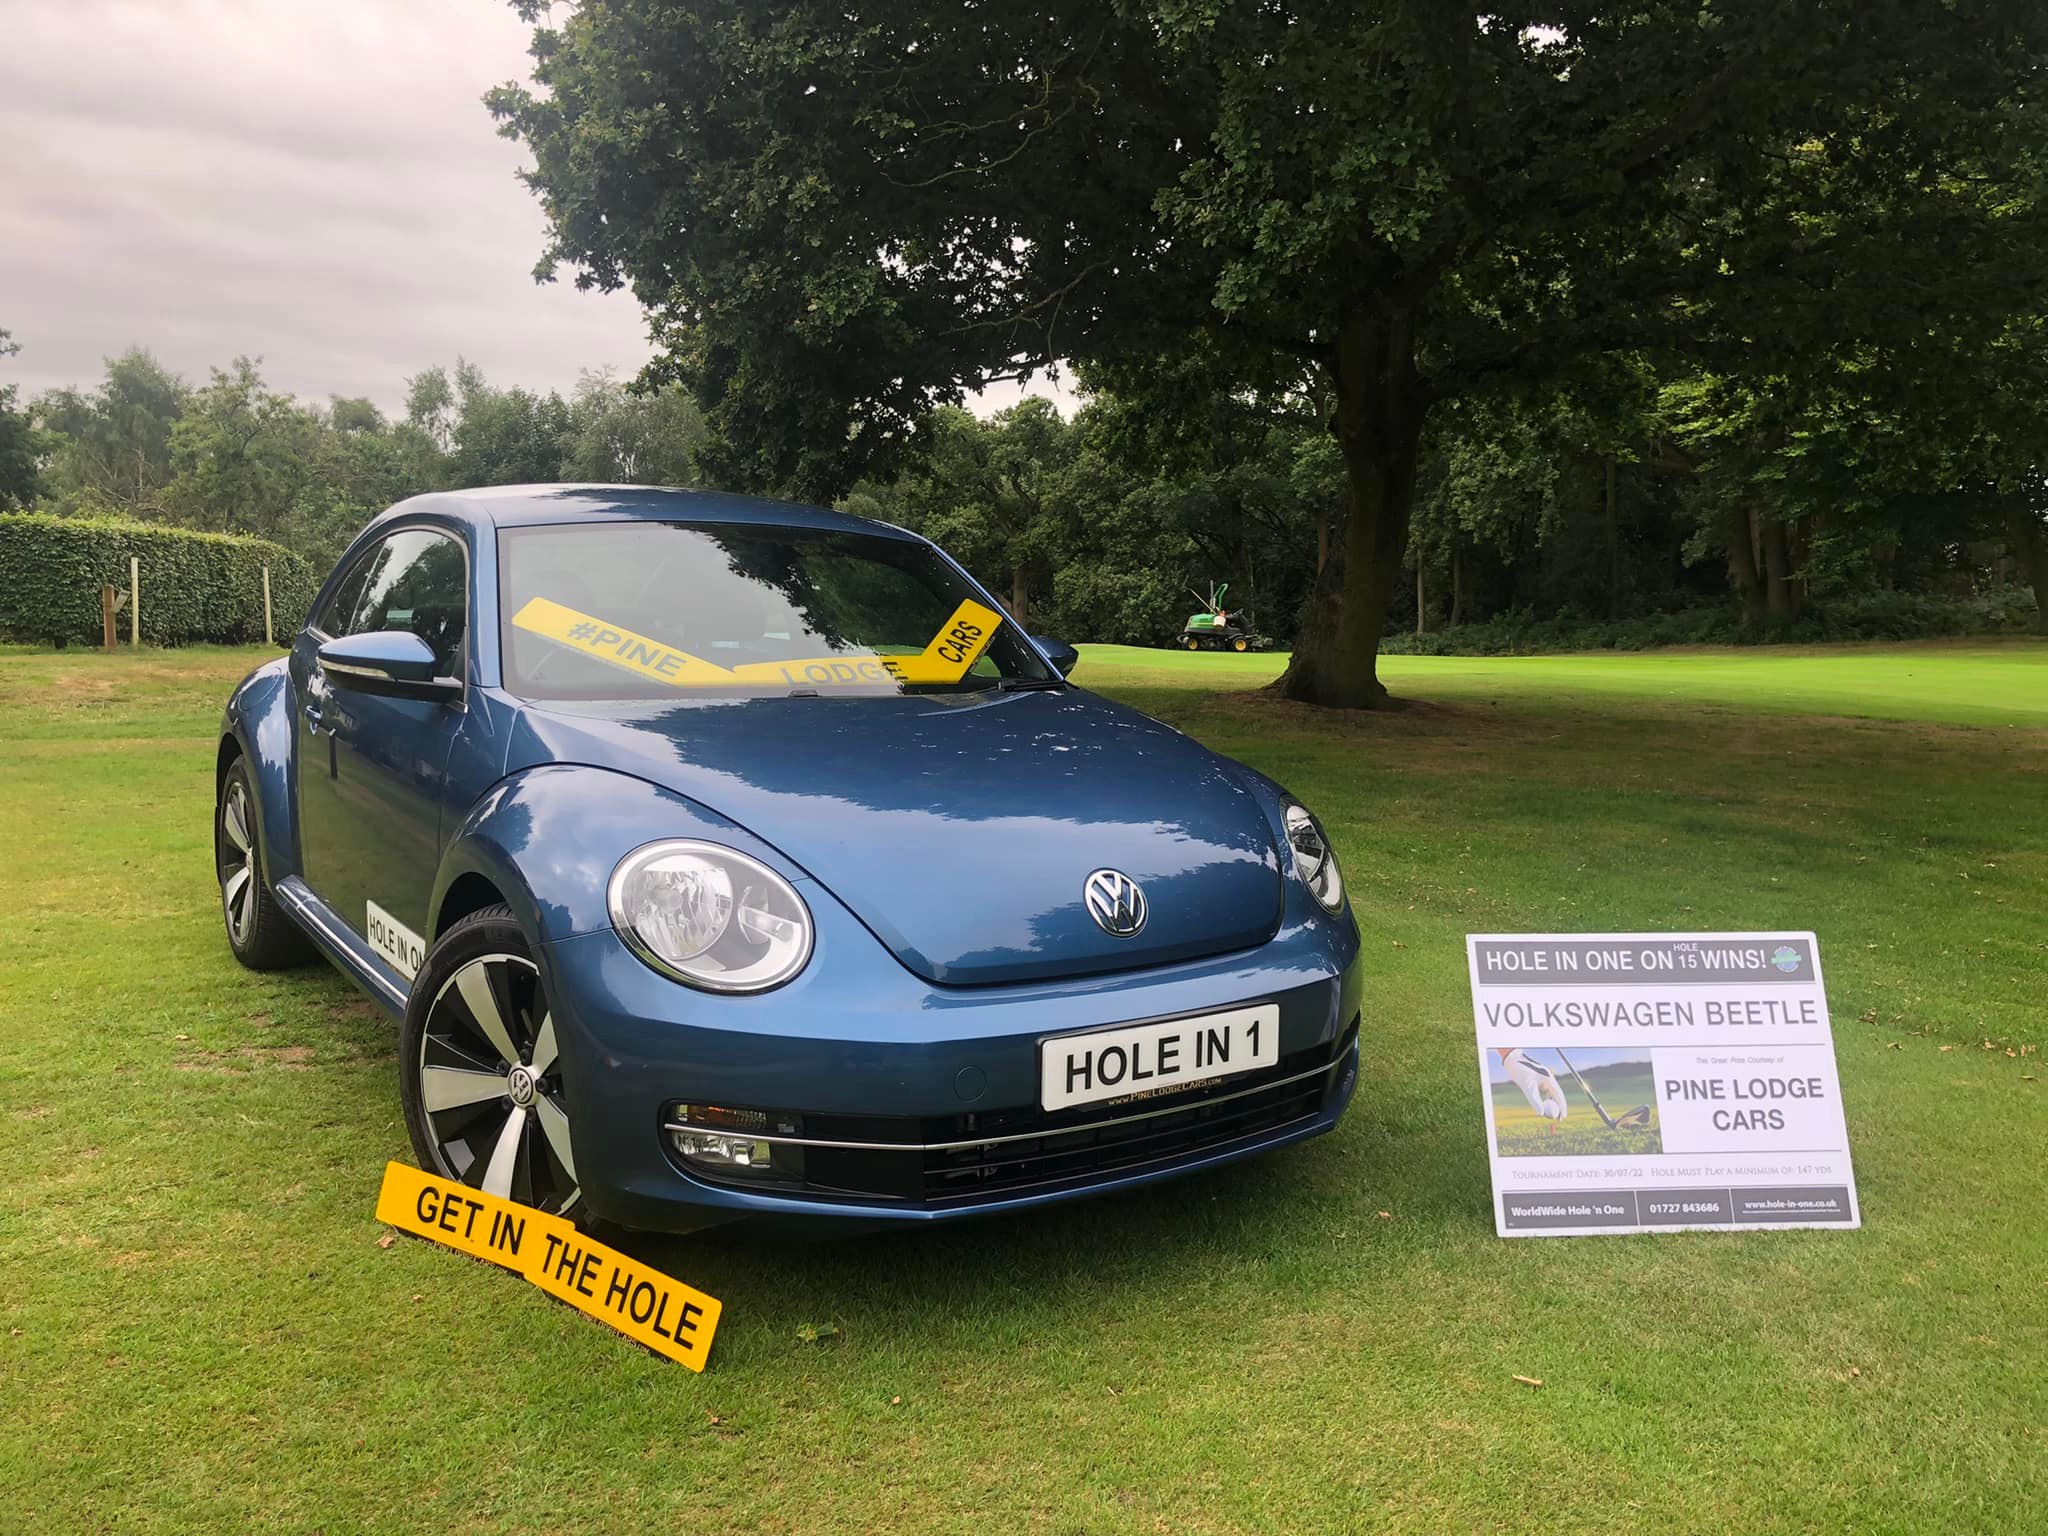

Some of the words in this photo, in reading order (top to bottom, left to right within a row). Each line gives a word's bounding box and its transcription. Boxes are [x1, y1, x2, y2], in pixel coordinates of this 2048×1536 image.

[566, 621, 688, 678] #PINE
[779, 661, 908, 687] LODGE
[938, 621, 982, 663] CARS
[369, 914, 395, 955] HOLE
[397, 935, 408, 965] IN
[1672, 943, 1698, 951] HOLE
[1486, 950, 1549, 971] HOLE
[1554, 950, 1578, 971] IN
[1585, 950, 1634, 971] ONE
[1640, 950, 1673, 970] ON
[1678, 954, 1697, 969] 15
[1700, 949, 1767, 969] WINS!
[1483, 1001, 1694, 1028] VOLKSWAGEN
[1705, 1000, 1818, 1025] BEETLE
[1065, 1034, 1181, 1094] HOLE
[1195, 1025, 1230, 1069] IN
[1246, 1020, 1260, 1057] 1
[1665, 1079, 1726, 1101] PINE
[1733, 1078, 1825, 1100] LODGE
[1712, 1109, 1785, 1131] CARS
[1511, 1206, 1566, 1217] WorldWide
[1568, 1205, 1591, 1216] Hole
[1603, 1205, 1625, 1215] One
[1649, 1204, 1680, 1214] 01727
[1682, 1203, 1720, 1213] 843686
[1744, 1199, 1838, 1209] www.hole-in-one.co.uk
[416, 1185, 485, 1239] GET
[488, 1210, 527, 1257] IN
[542, 1232, 603, 1298] THE
[604, 1266, 704, 1350] HOLE
